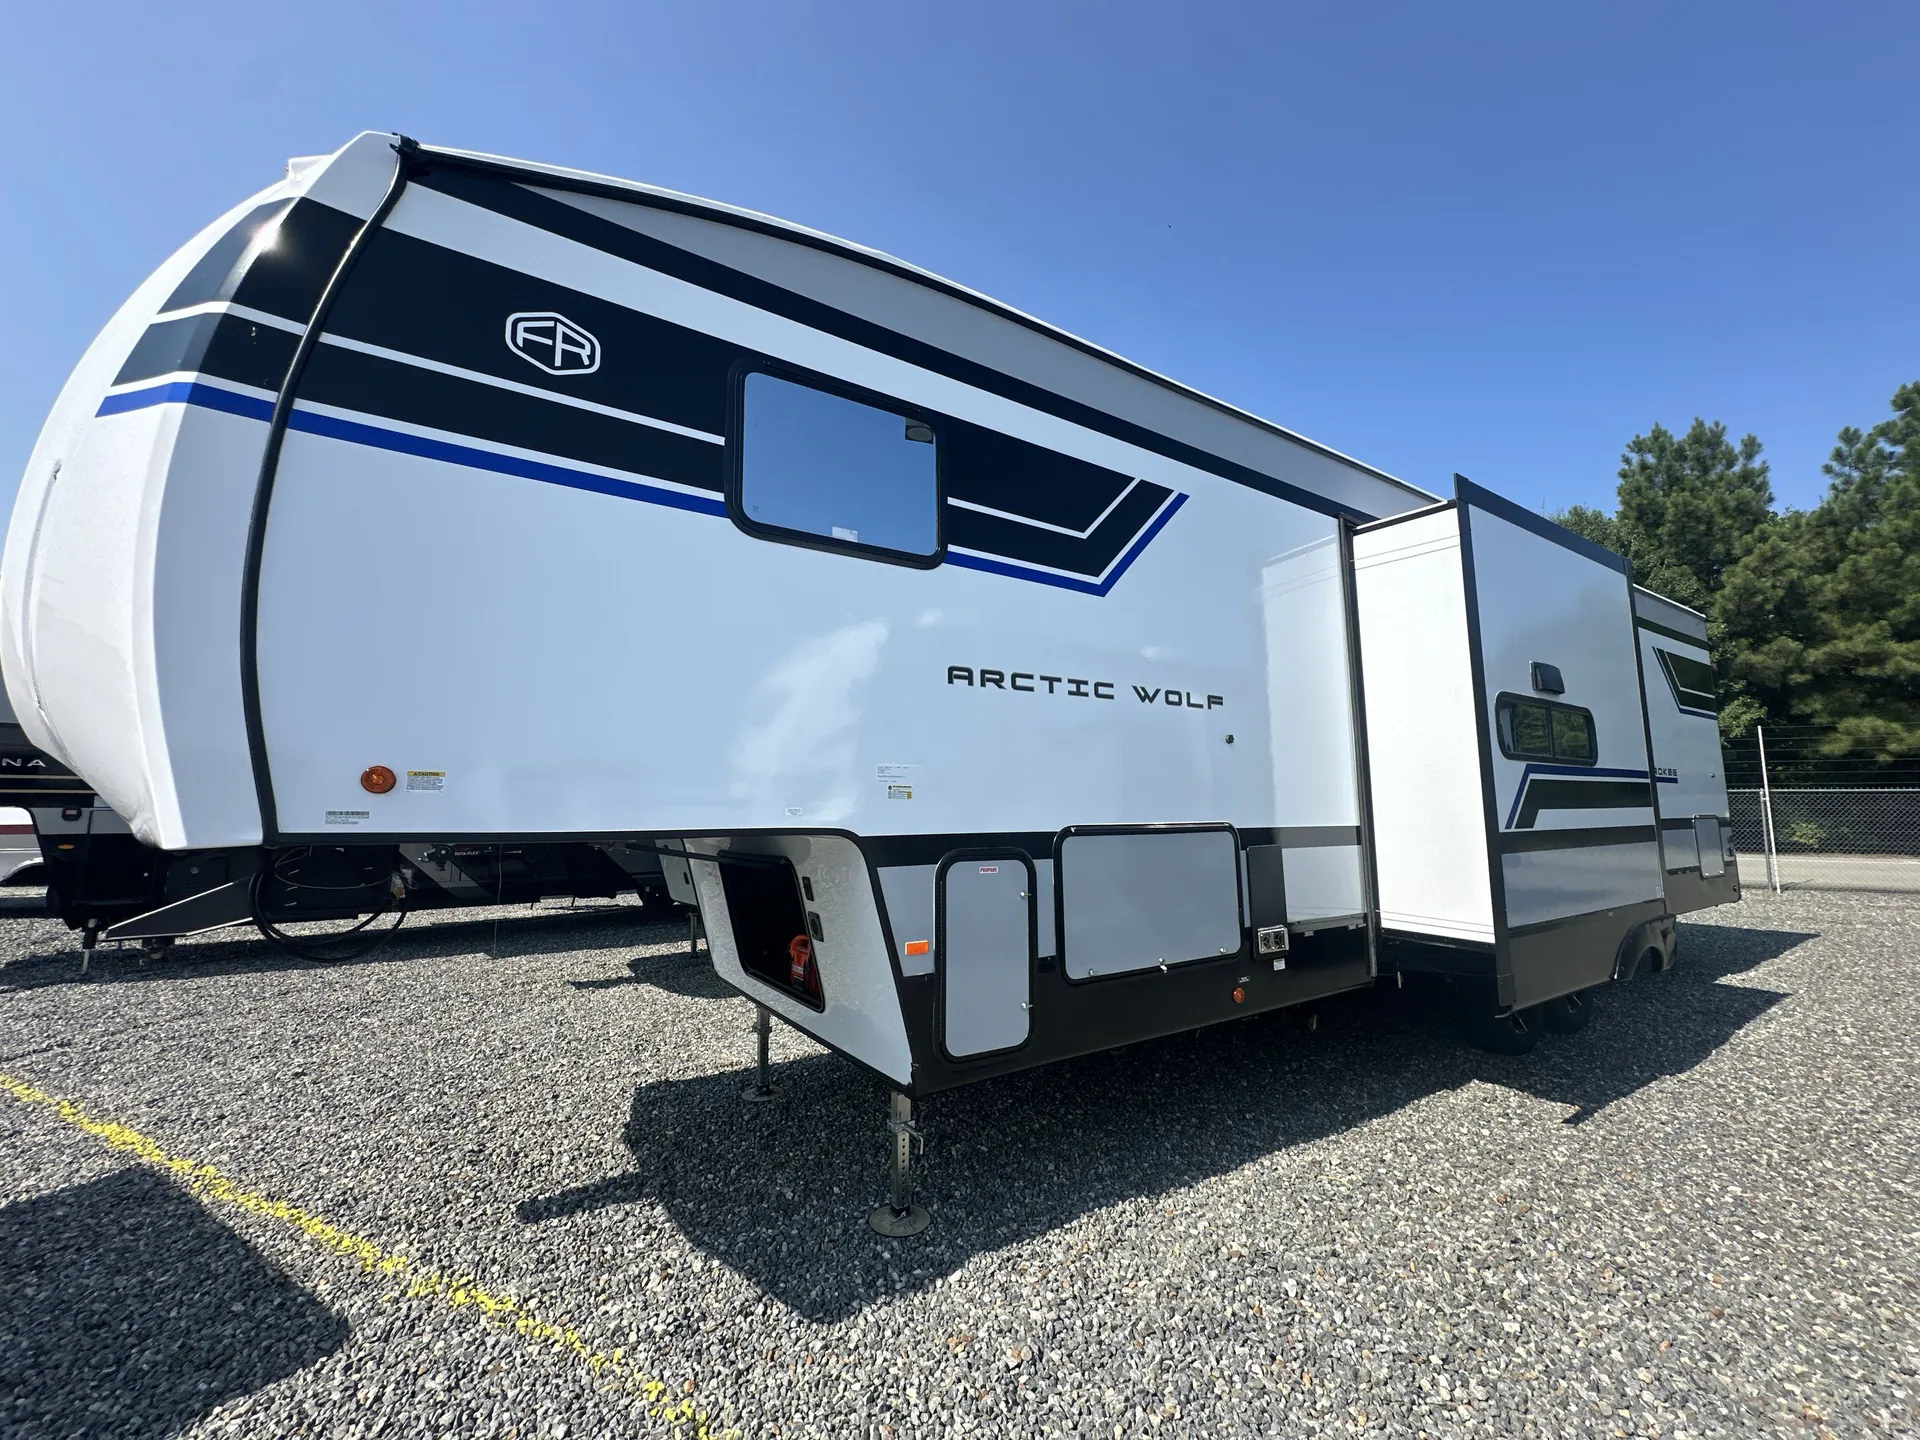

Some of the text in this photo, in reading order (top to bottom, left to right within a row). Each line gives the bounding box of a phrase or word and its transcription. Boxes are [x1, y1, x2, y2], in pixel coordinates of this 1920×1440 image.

[516, 320, 591, 367] FR
[947, 665, 1224, 710] ARCTIC WOLF
